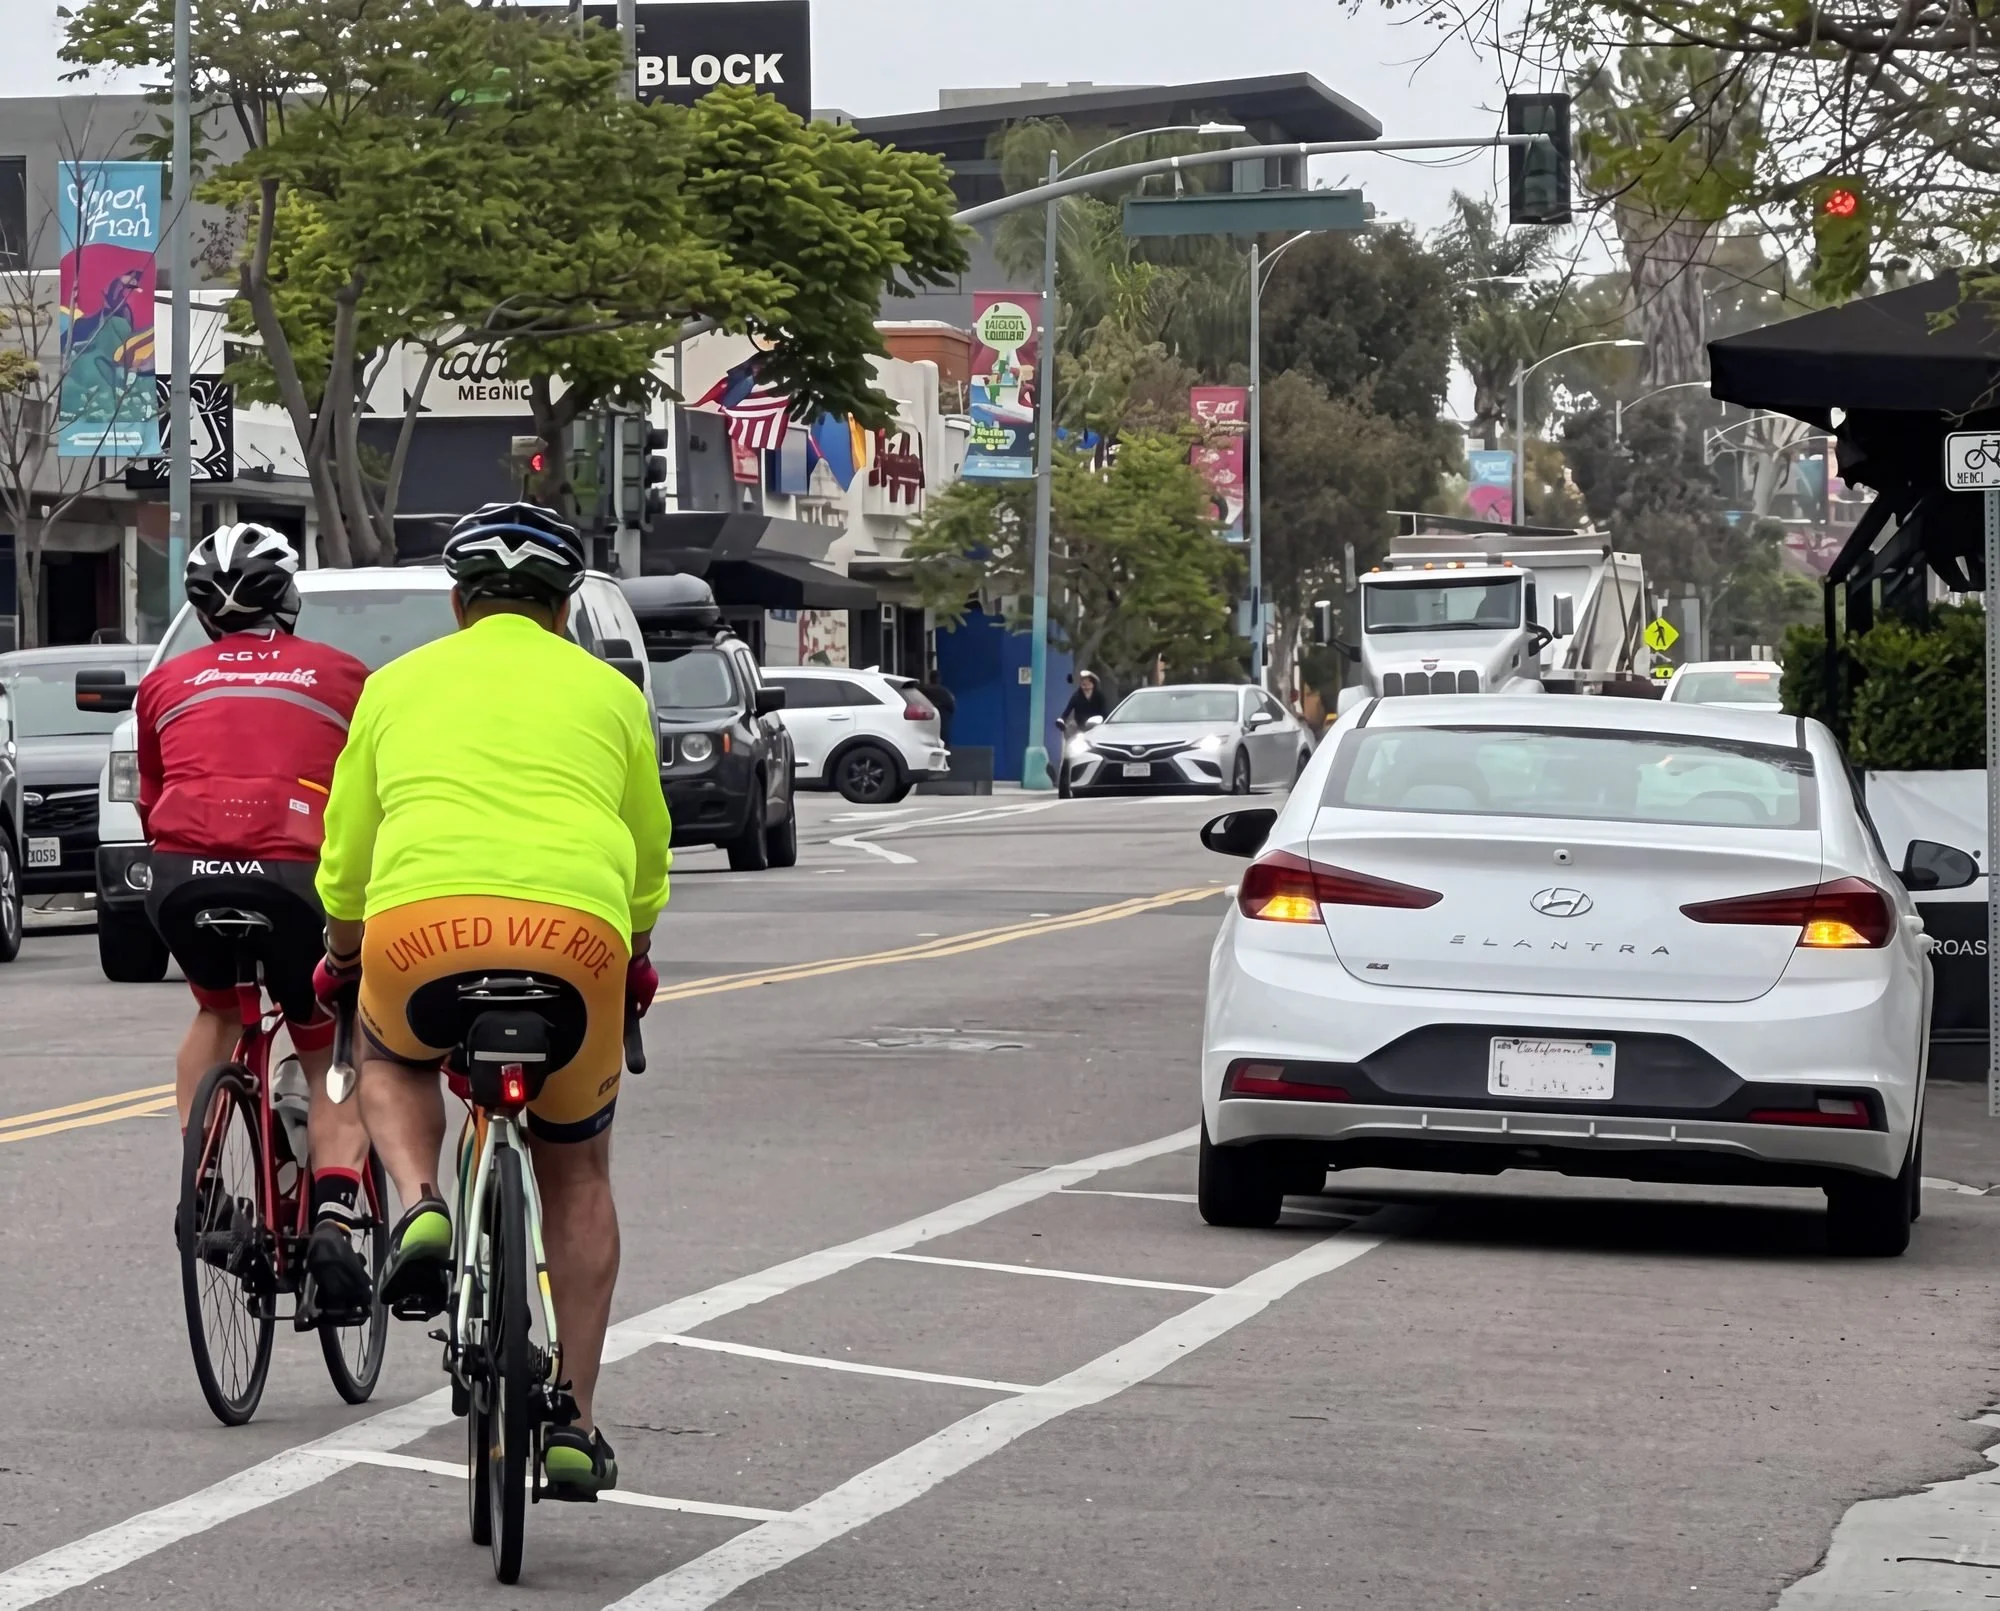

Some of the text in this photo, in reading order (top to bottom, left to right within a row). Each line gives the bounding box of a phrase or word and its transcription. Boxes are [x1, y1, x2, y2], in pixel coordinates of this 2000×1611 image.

[638, 53, 785, 87] BLOCK
[385, 916, 616, 980] UNITED WE RIDE
[1449, 934, 1670, 956] ELANTRA
